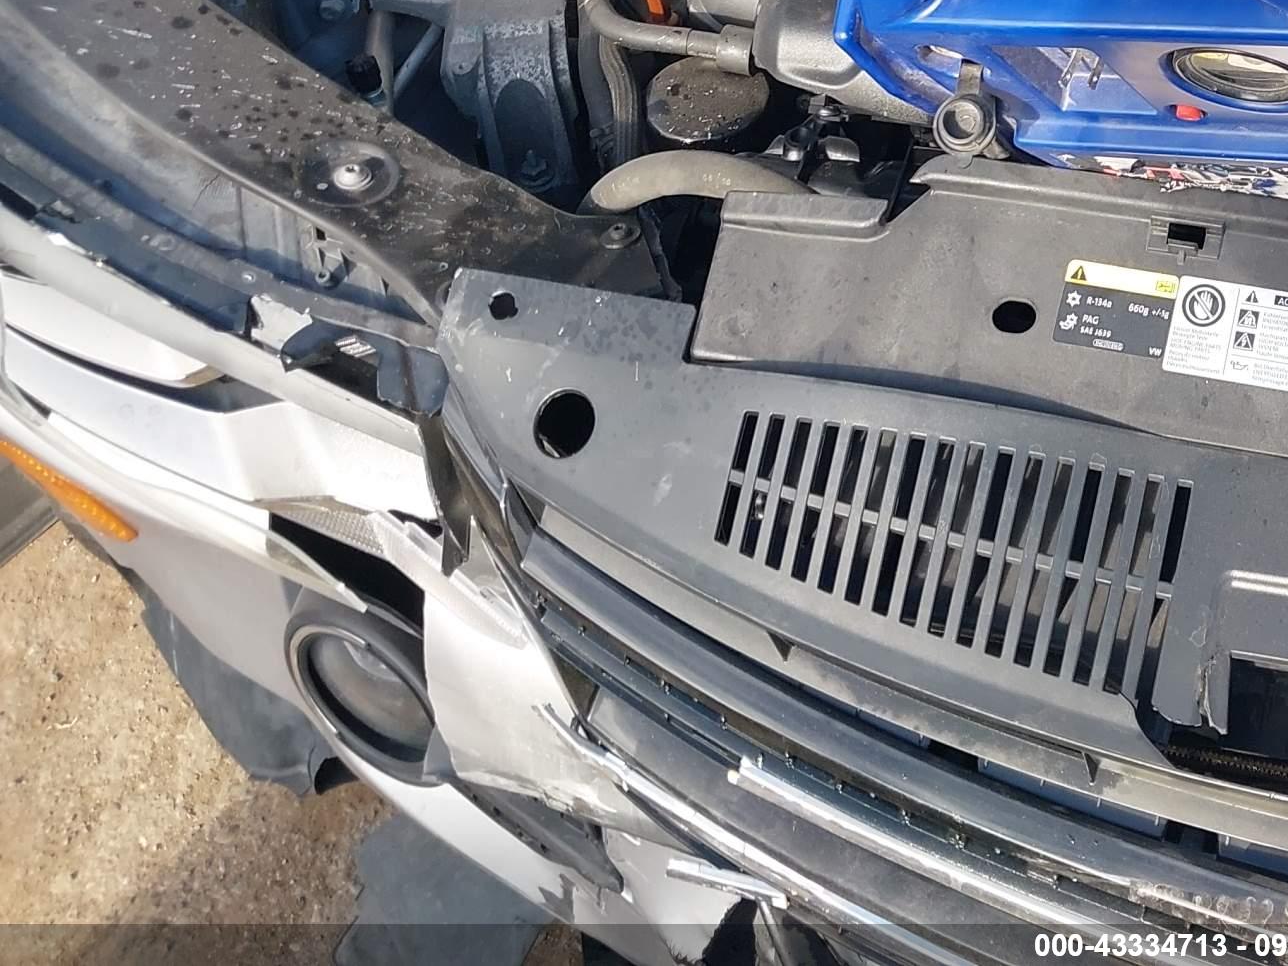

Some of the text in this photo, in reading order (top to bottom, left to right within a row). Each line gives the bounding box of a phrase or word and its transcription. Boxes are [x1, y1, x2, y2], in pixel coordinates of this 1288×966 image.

[1086, 296, 1112, 308] R-134a
[1082, 314, 1099, 325] PAG
[1080, 326, 1093, 335] SAE
[1148, 346, 1162, 357] VW
